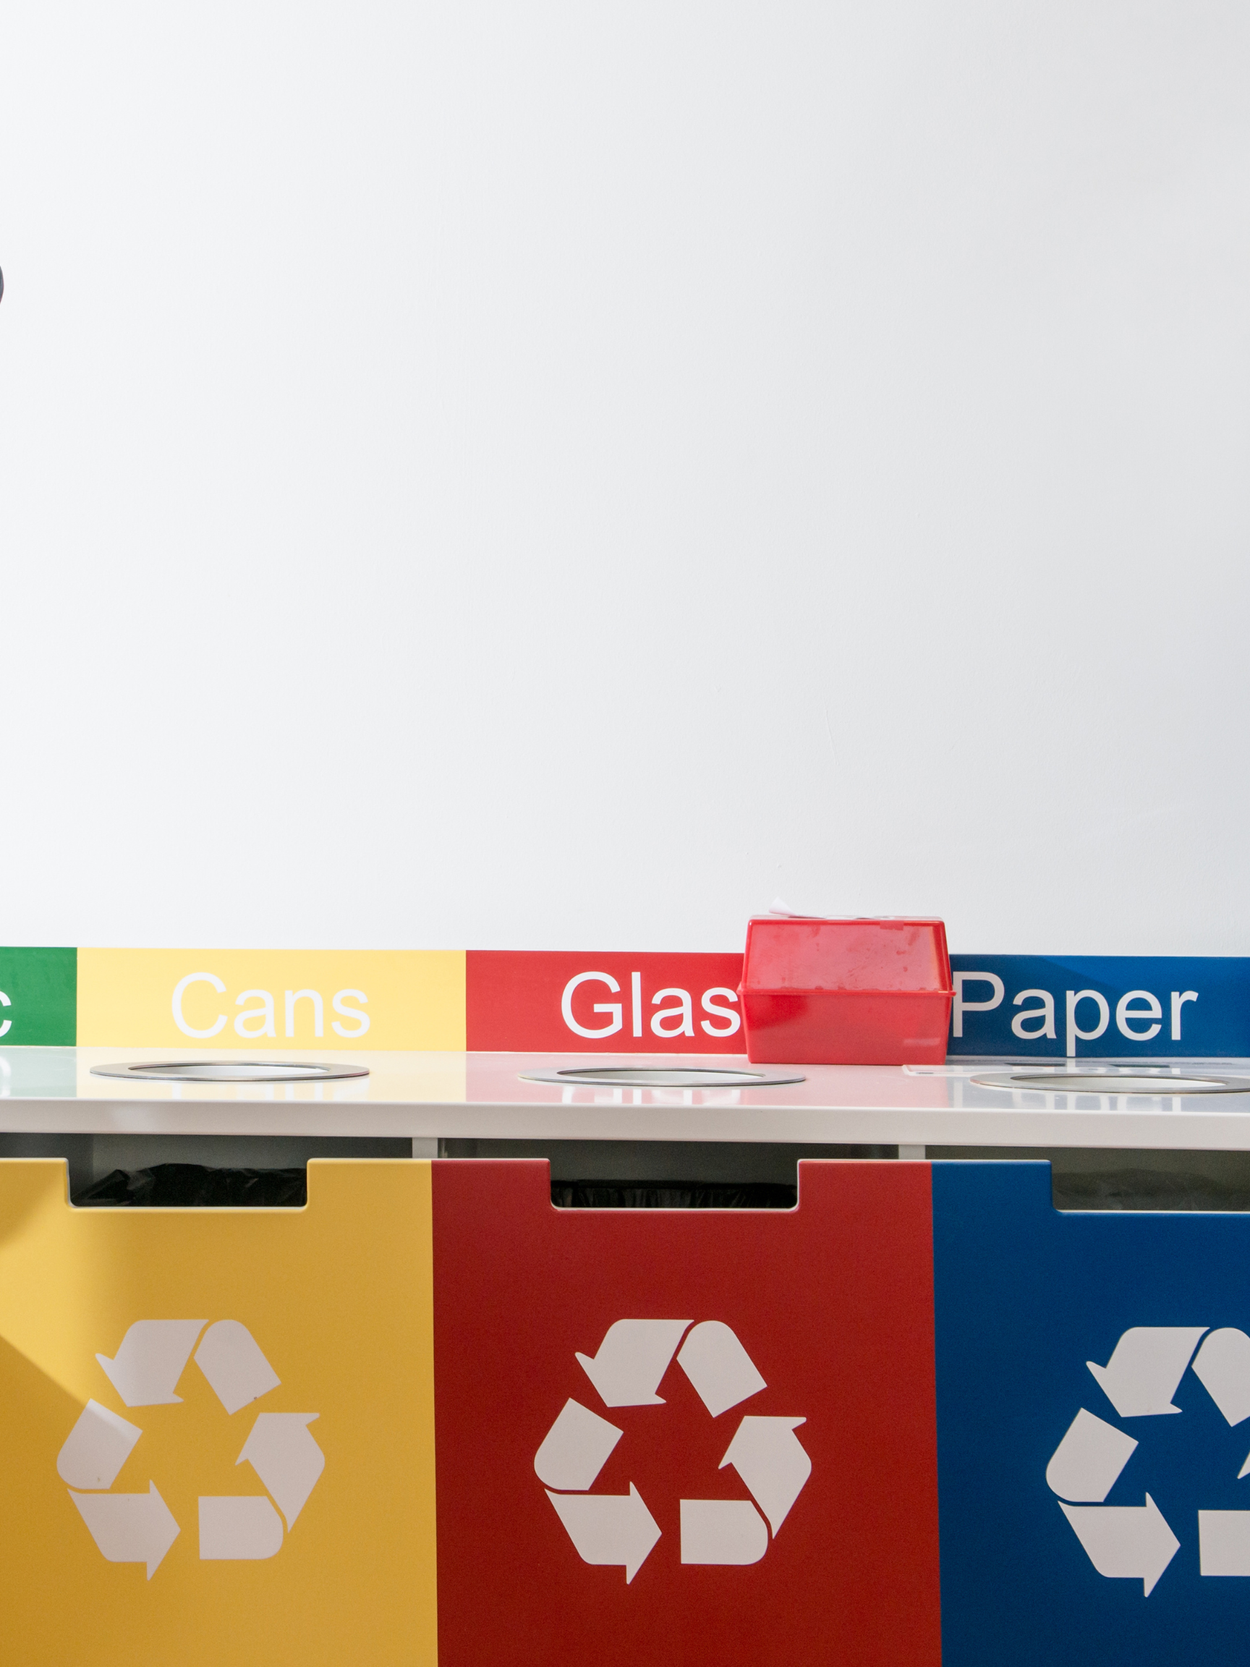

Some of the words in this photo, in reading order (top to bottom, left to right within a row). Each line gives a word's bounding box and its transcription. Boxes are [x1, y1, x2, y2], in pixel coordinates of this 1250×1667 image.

[172, 972, 371, 1039] Cans
[561, 971, 741, 1039] Glas
[953, 971, 1199, 1058] Paper
